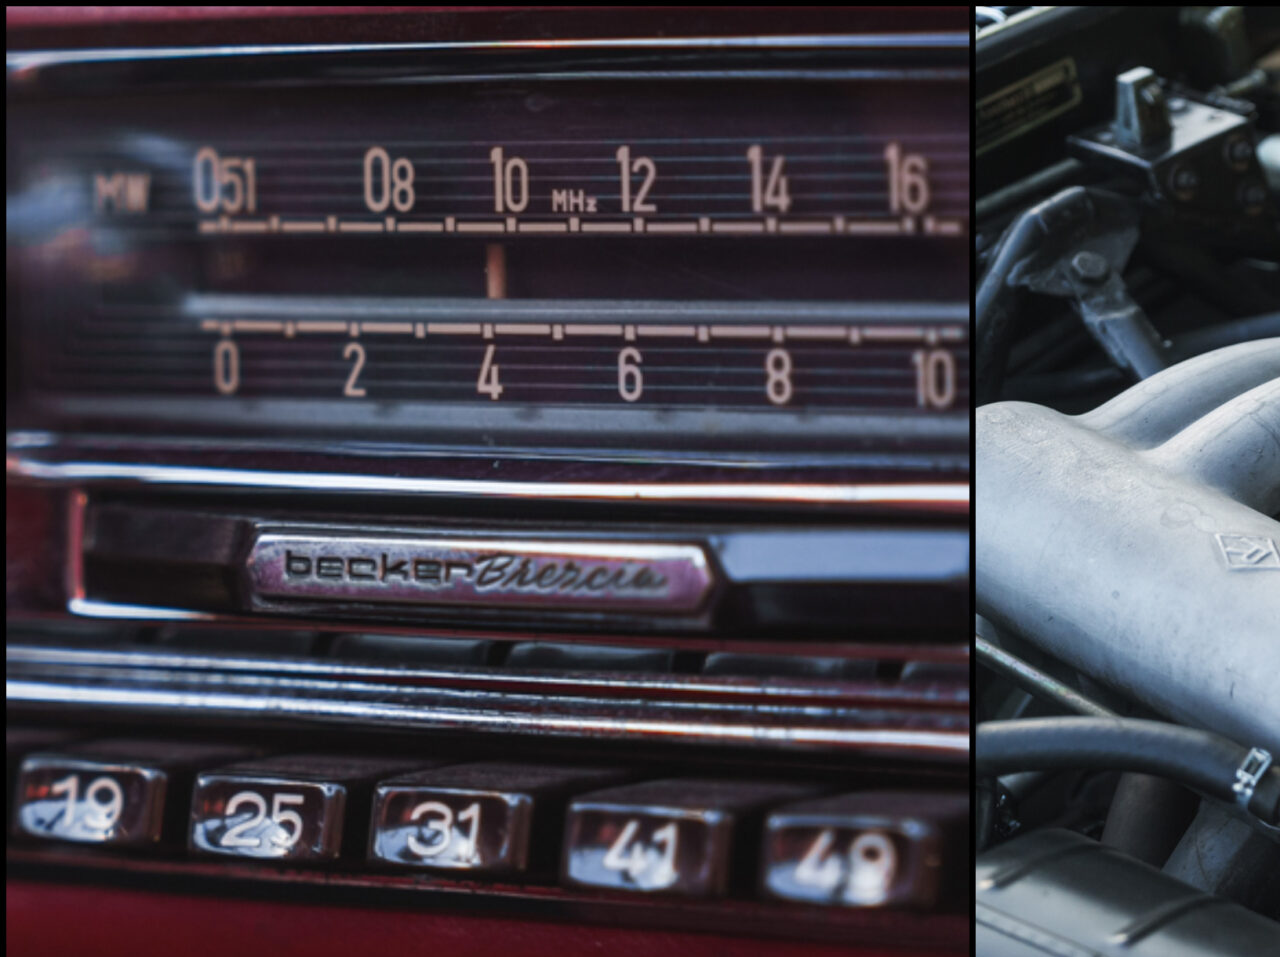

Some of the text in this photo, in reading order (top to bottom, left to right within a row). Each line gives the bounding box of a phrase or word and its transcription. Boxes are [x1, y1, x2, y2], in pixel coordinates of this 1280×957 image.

[363, 147, 415, 213] 08
[490, 147, 528, 213] 10
[552, 189, 597, 213] MHz
[615, 146, 657, 213] 12
[747, 145, 791, 213] 14
[885, 142, 929, 214] 16
[214, 340, 955, 407] 0 2 4 6 8 10
[284, 549, 475, 583] becker
[51, 775, 125, 830] 19
[219, 790, 305, 849] 25
[407, 800, 482, 859] 31
[602, 819, 679, 882] 41
[794, 828, 897, 902] 49
